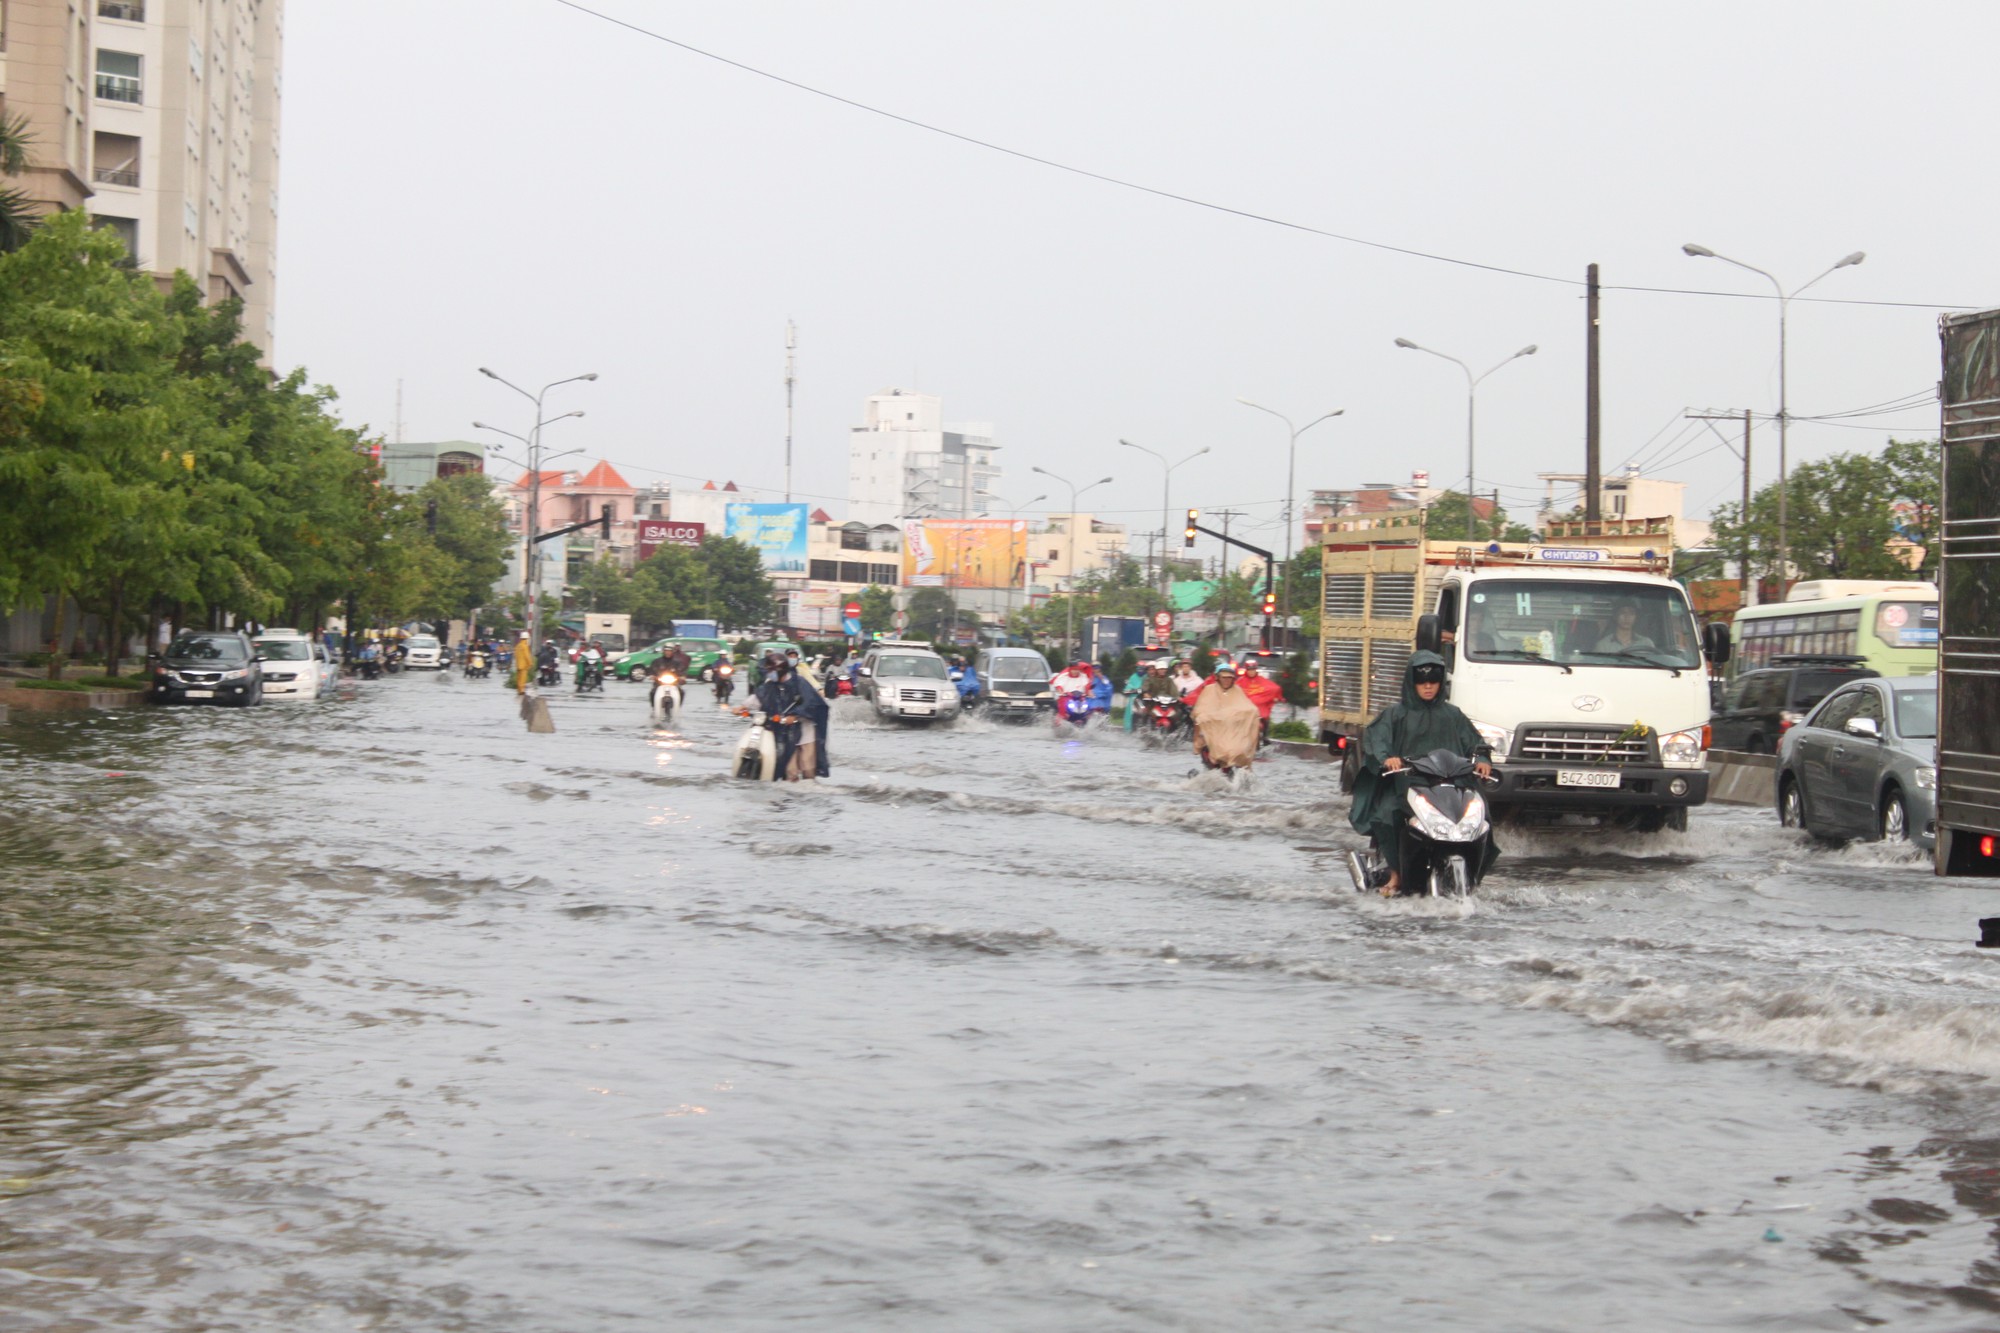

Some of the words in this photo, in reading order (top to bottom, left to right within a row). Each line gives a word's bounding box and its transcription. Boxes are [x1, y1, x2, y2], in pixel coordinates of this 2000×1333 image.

[644, 526, 698, 539] ISALCO
[1552, 550, 1589, 560] HYUNDAI
[1515, 592, 1532, 616] H
[1560, 772, 1617, 786] 54Z-9007
